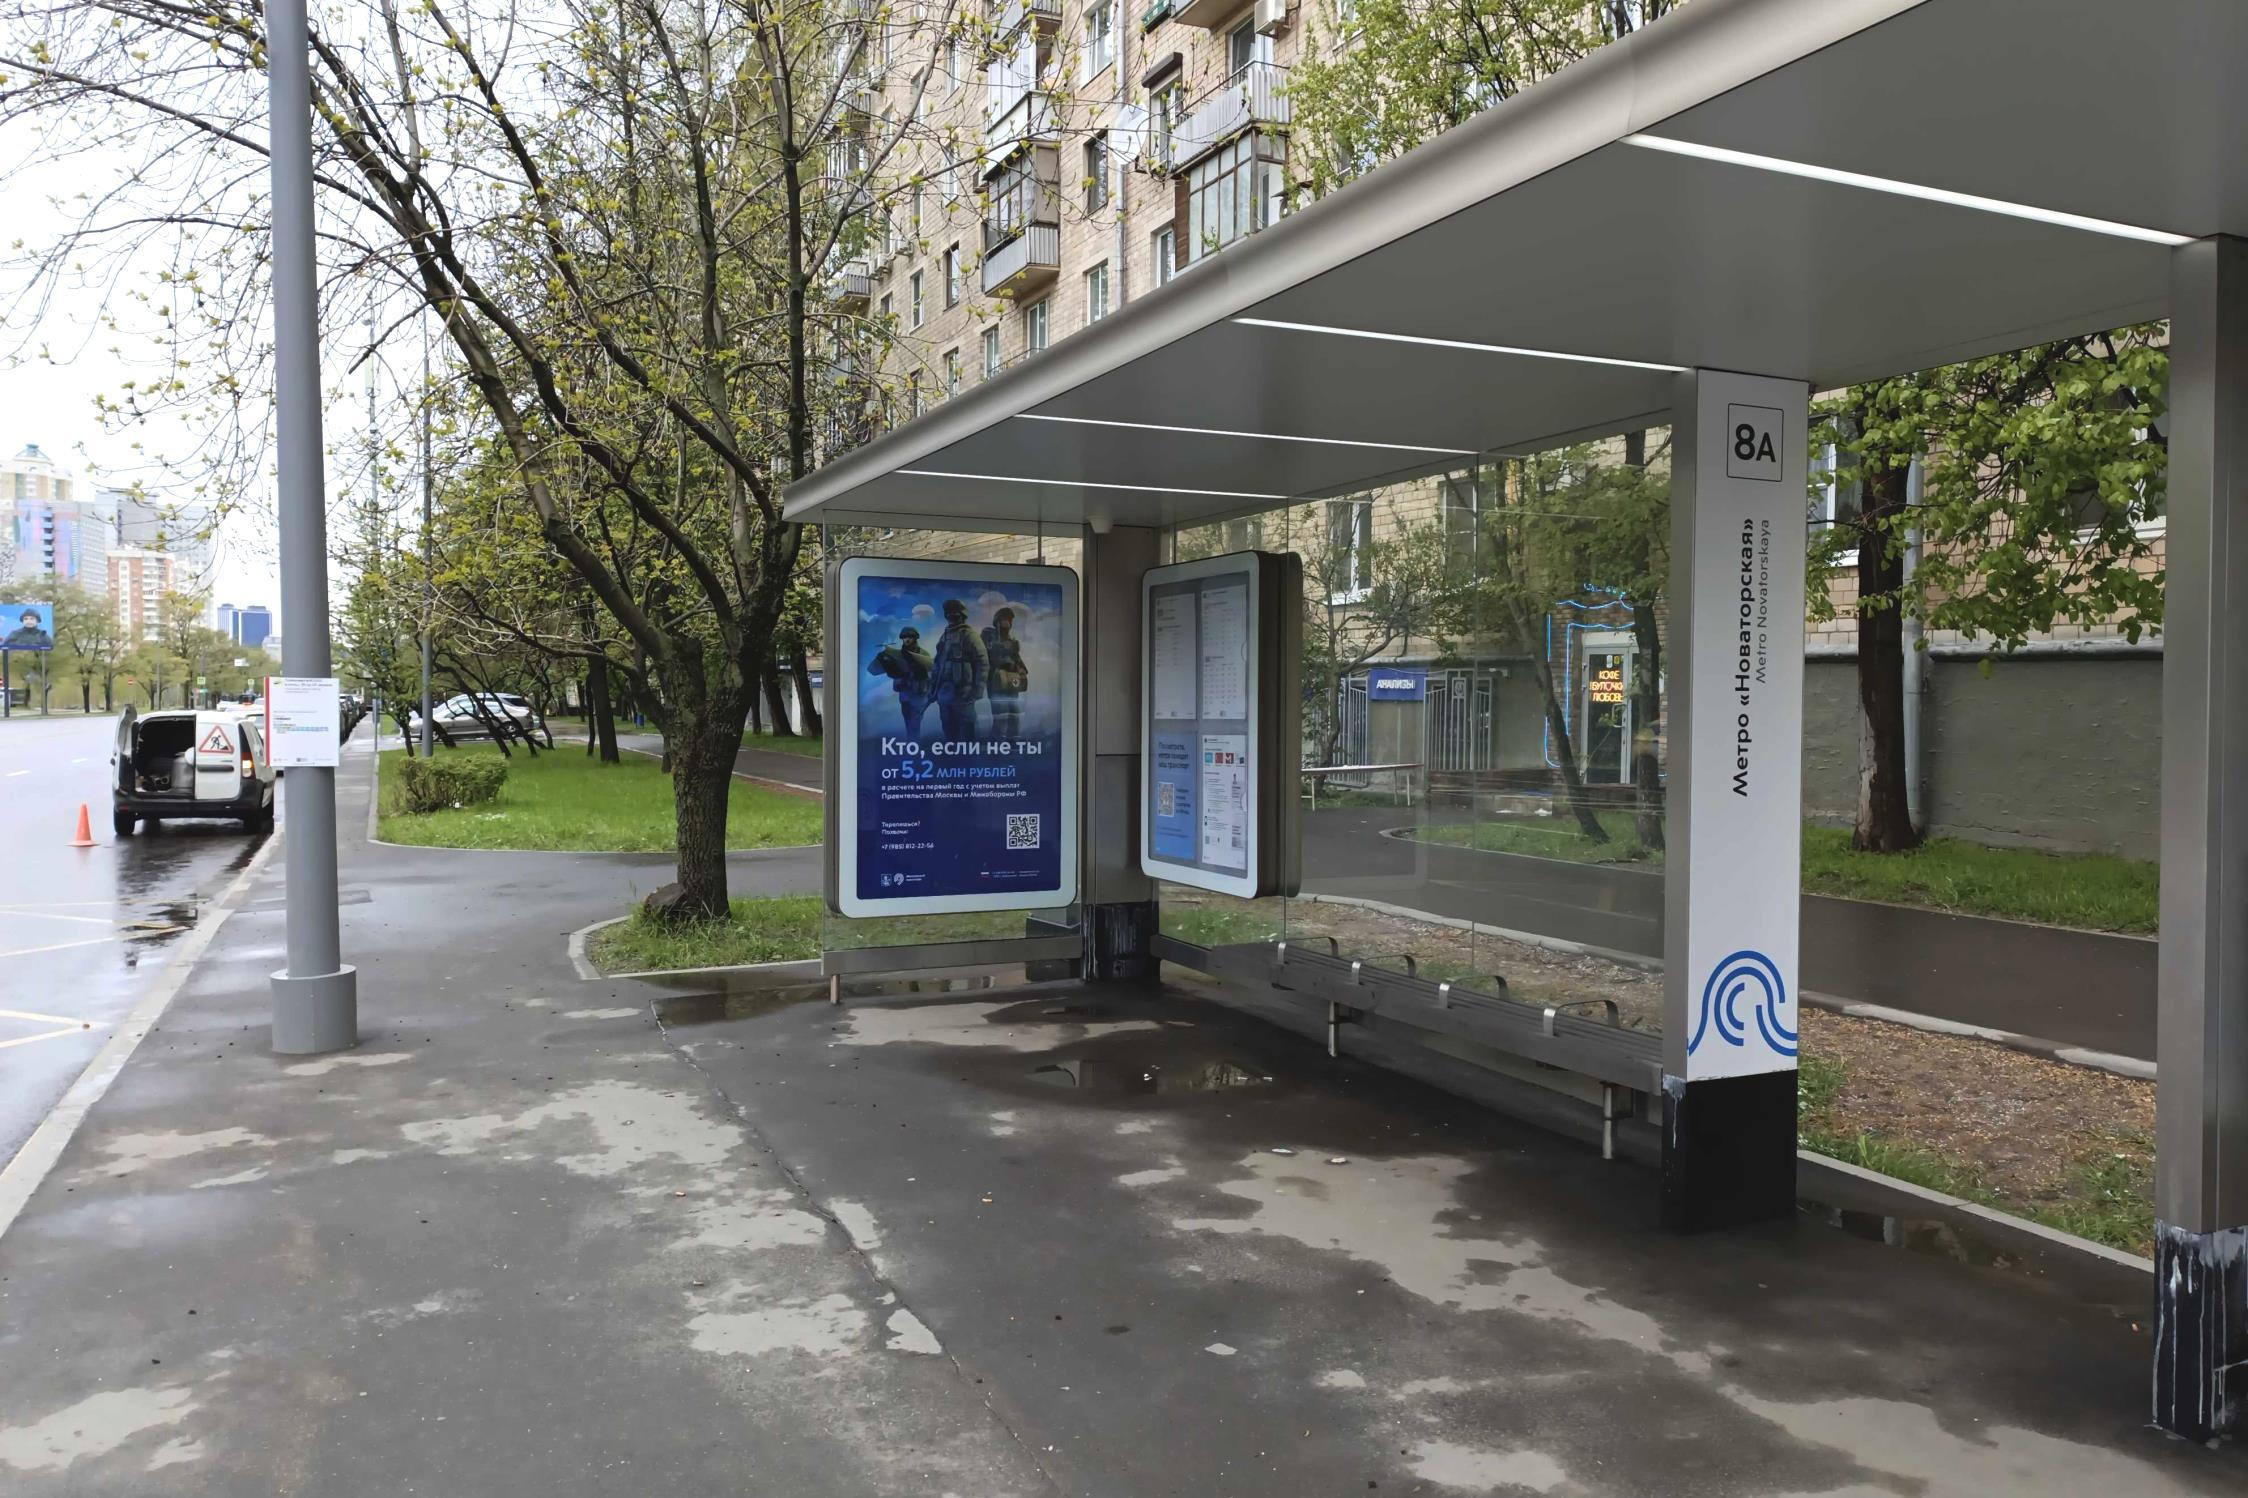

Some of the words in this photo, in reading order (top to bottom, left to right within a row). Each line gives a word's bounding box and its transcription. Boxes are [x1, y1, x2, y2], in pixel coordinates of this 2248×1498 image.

[1757, 518, 1770, 627] Novatorskaya
[1734, 517, 1754, 706] «Новаторская»
[1755, 633, 1768, 685] Metro
[1376, 679, 1415, 690] АНАЛИЗЫ
[1599, 670, 1620, 680] КОФЕ
[882, 737, 926, 759] Кто,
[931, 741, 980, 755] если
[987, 741, 1011, 755] не
[1016, 741, 1042, 755] ты
[1732, 712, 1752, 797] Метро
[881, 768, 899, 779] от
[901, 760, 934, 782] 5,2
[936, 767, 966, 778] МЛН
[969, 765, 1016, 778] РУБЛЕЙ
[881, 792, 934, 800] Правительства
[925, 783, 952, 791] первый
